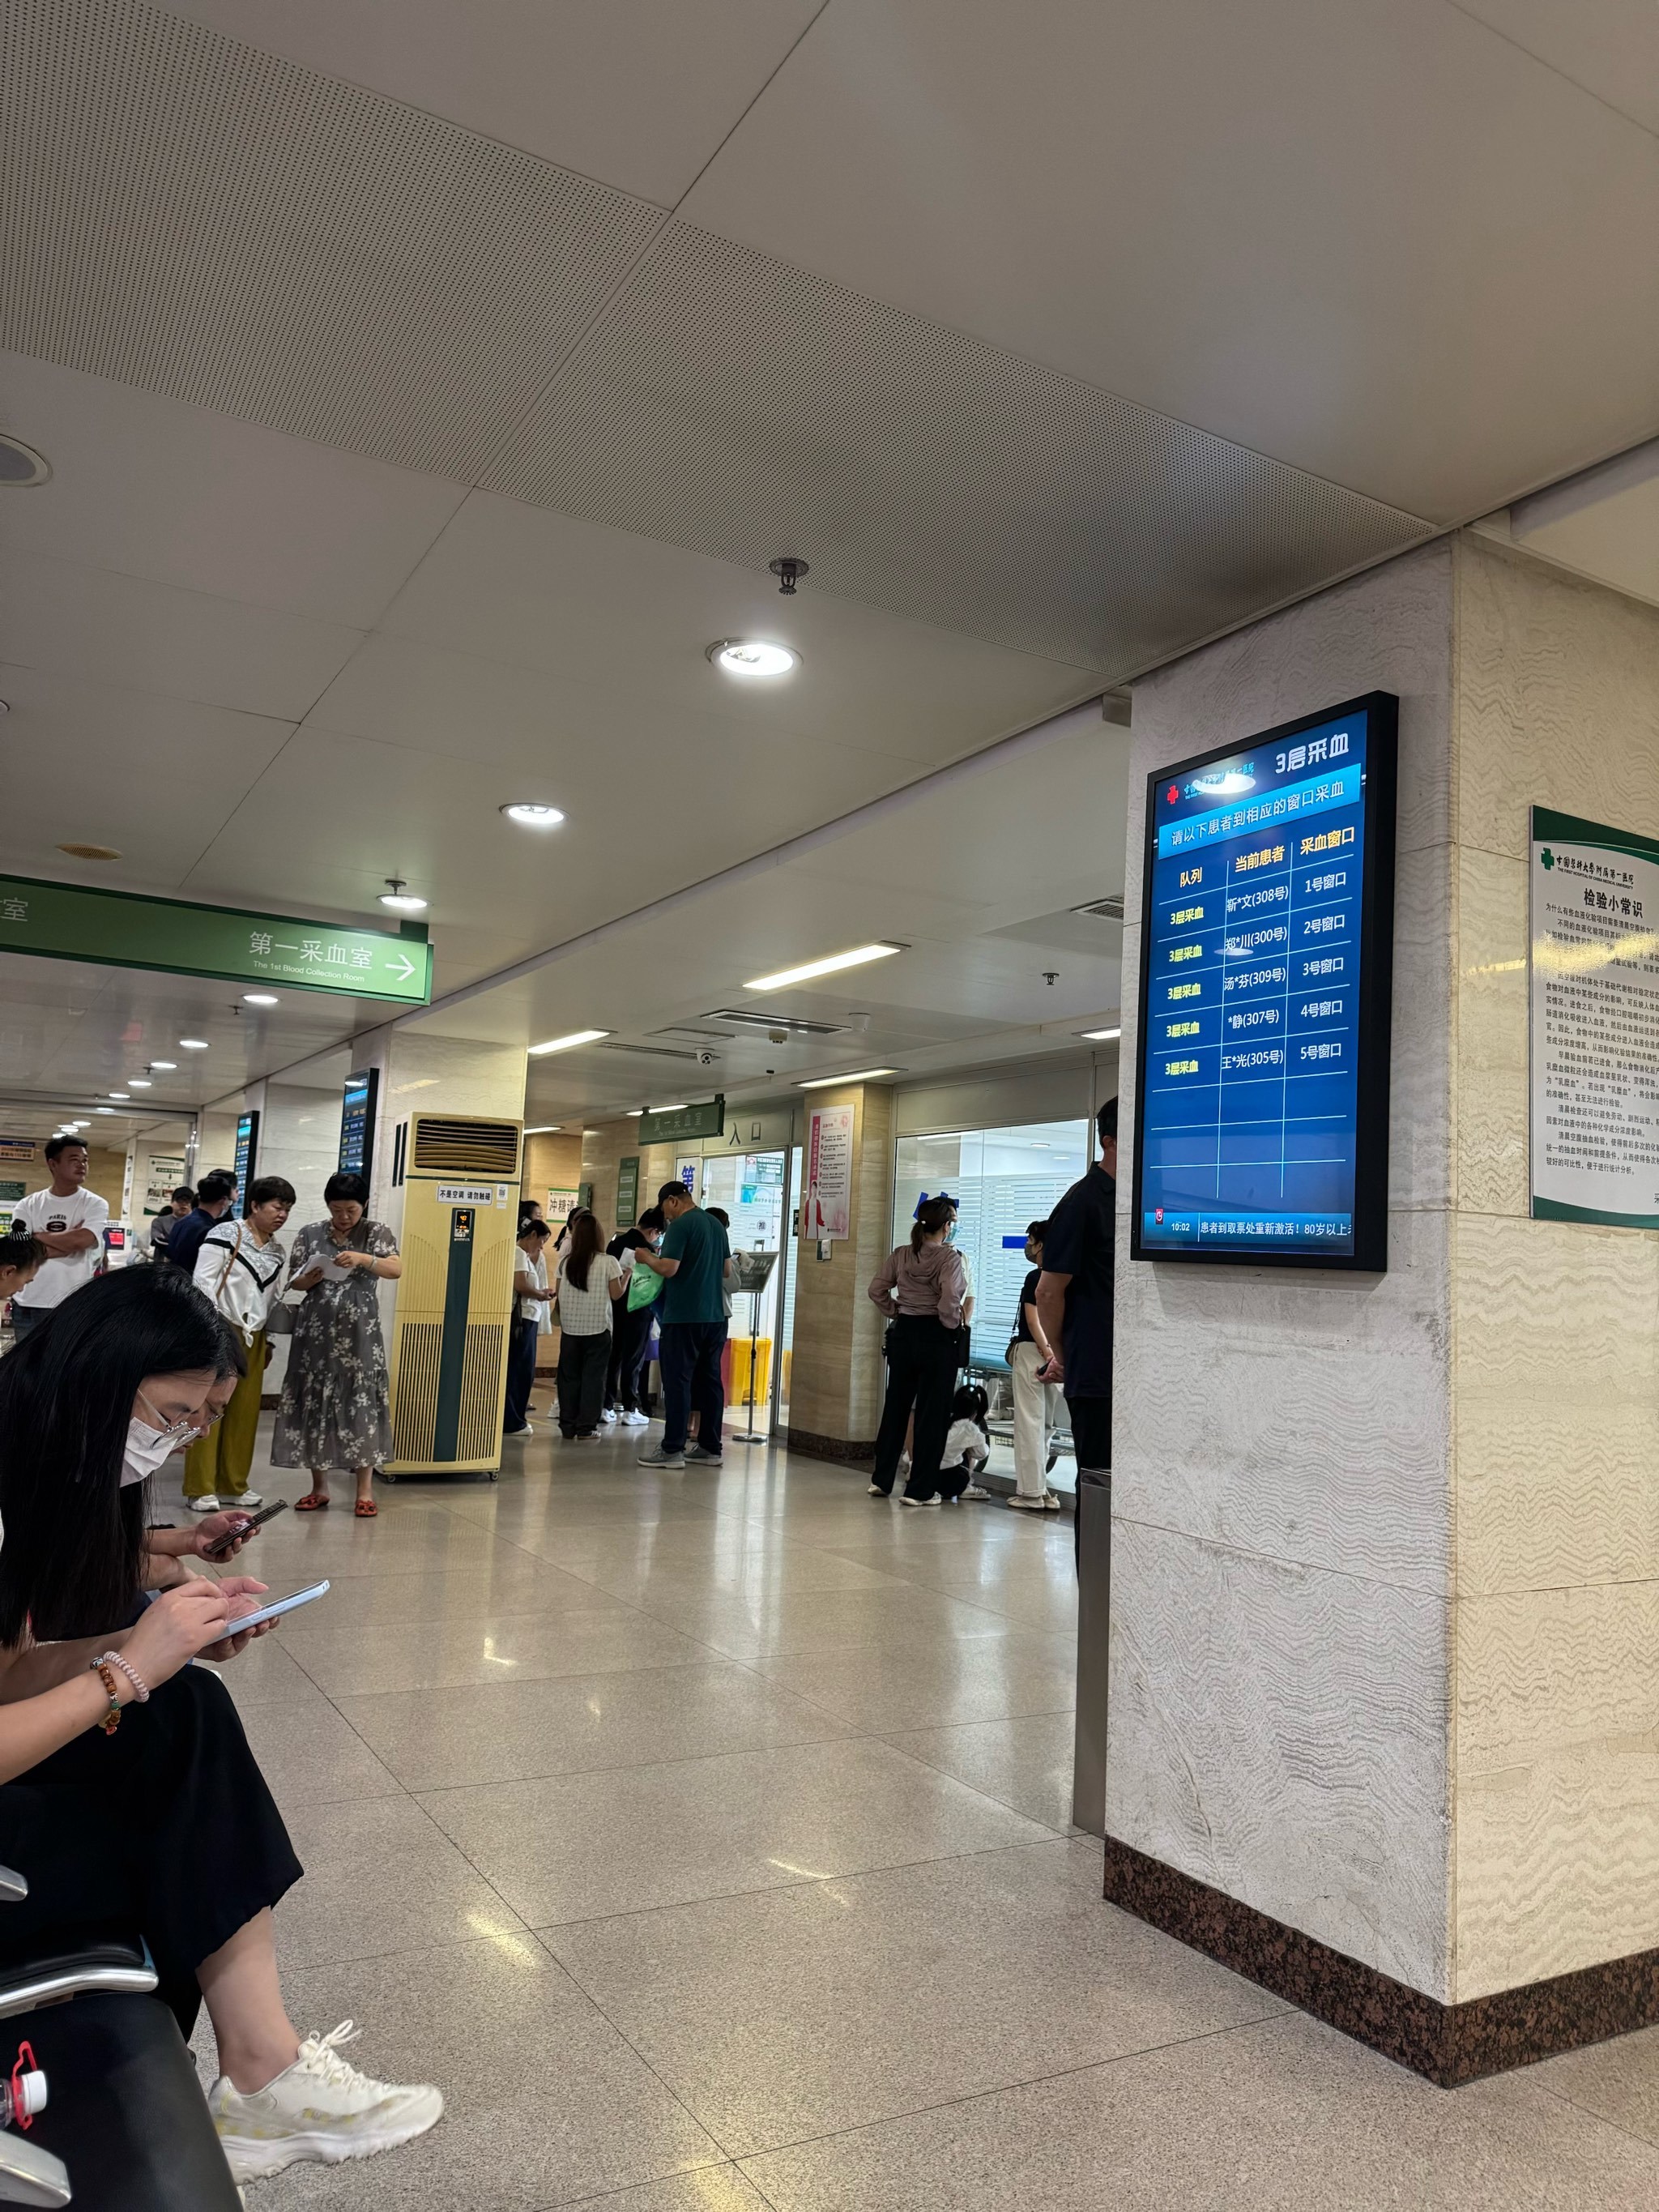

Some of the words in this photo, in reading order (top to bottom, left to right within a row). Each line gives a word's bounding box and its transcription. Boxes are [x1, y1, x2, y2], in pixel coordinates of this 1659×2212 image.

[1275, 732, 1350, 774] 3层采血
[1171, 781, 1345, 846] 请以下患者到相应的窗口采血
[1179, 866, 1203, 888] 队列
[1235, 845, 1286, 873] 当前患者
[1300, 826, 1355, 856] 采血窗口
[0, 897, 28, 921] 室
[1170, 906, 1205, 925] 3层采血
[1305, 872, 1346, 893] 1号窗口
[1584, 887, 1643, 919] 检验小常识
[249, 931, 373, 970] 第一采血室
[1169, 944, 1203, 963] 3层采血
[1304, 914, 1346, 934] 2号窗口
[254, 960, 268, 969] The
[270, 963, 281, 971] 1st
[283, 965, 305, 974] Blood
[305, 967, 342, 980] Collection
[343, 973, 365, 982] Room
[1167, 983, 1201, 1000] 3层采血
[1303, 957, 1344, 976] 3号窗口
[1166, 1021, 1200, 1038] 3层采血
[1300, 1000, 1343, 1018] 4号窗口
[1165, 1060, 1199, 1076] 3层采血
[1300, 1043, 1341, 1060] 5号窗口
[729, 1121, 761, 1146] 入口
[439, 1189, 464, 1198] 不是空调
[549, 1198, 578, 1213] 冲糖请
[1171, 1223, 1190, 1232] 10:02
